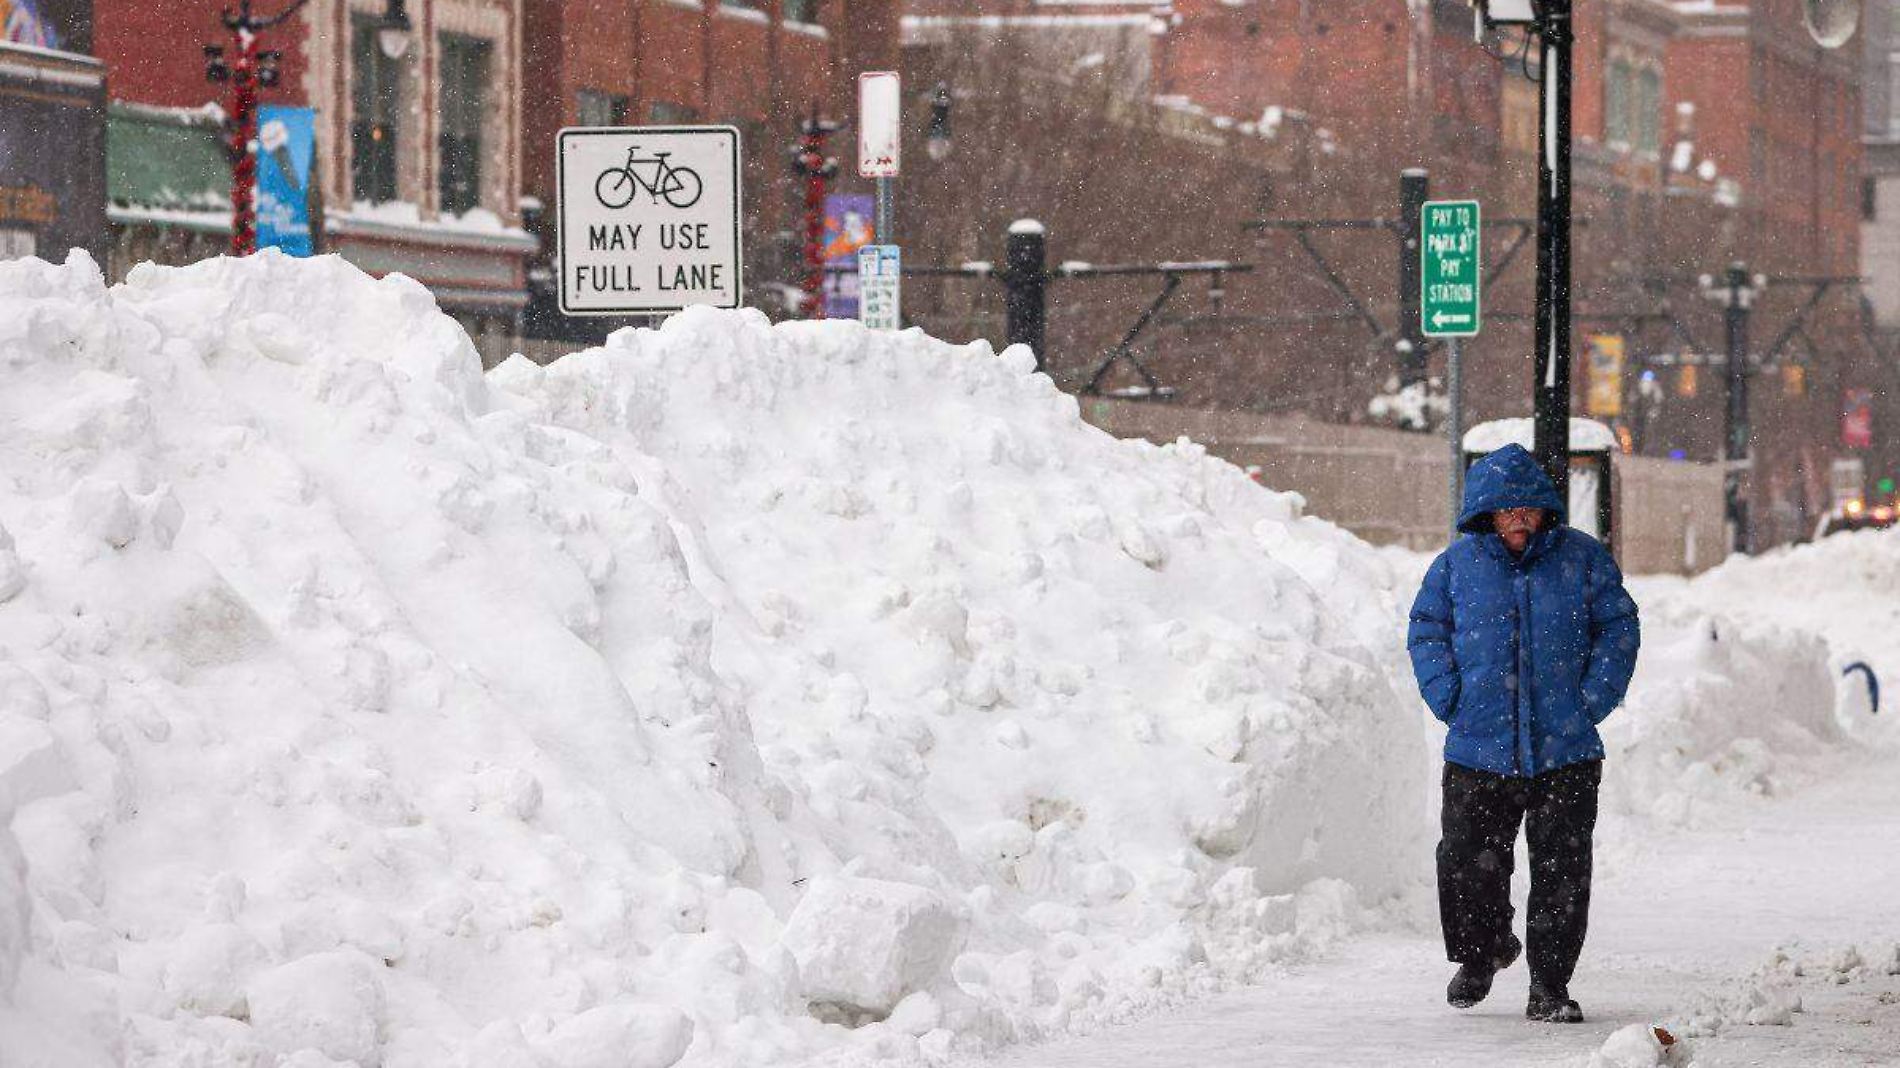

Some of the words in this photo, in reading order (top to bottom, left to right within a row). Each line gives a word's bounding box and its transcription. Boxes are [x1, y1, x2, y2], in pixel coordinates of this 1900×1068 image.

[1432, 208, 1453, 227] PAY
[1456, 207, 1471, 226] TO
[589, 224, 642, 251] MAY
[660, 224, 710, 249] USE
[1440, 258, 1460, 277] PAY
[576, 265, 641, 292] FULL
[658, 265, 724, 291] LANE
[1429, 284, 1473, 303] STATION
